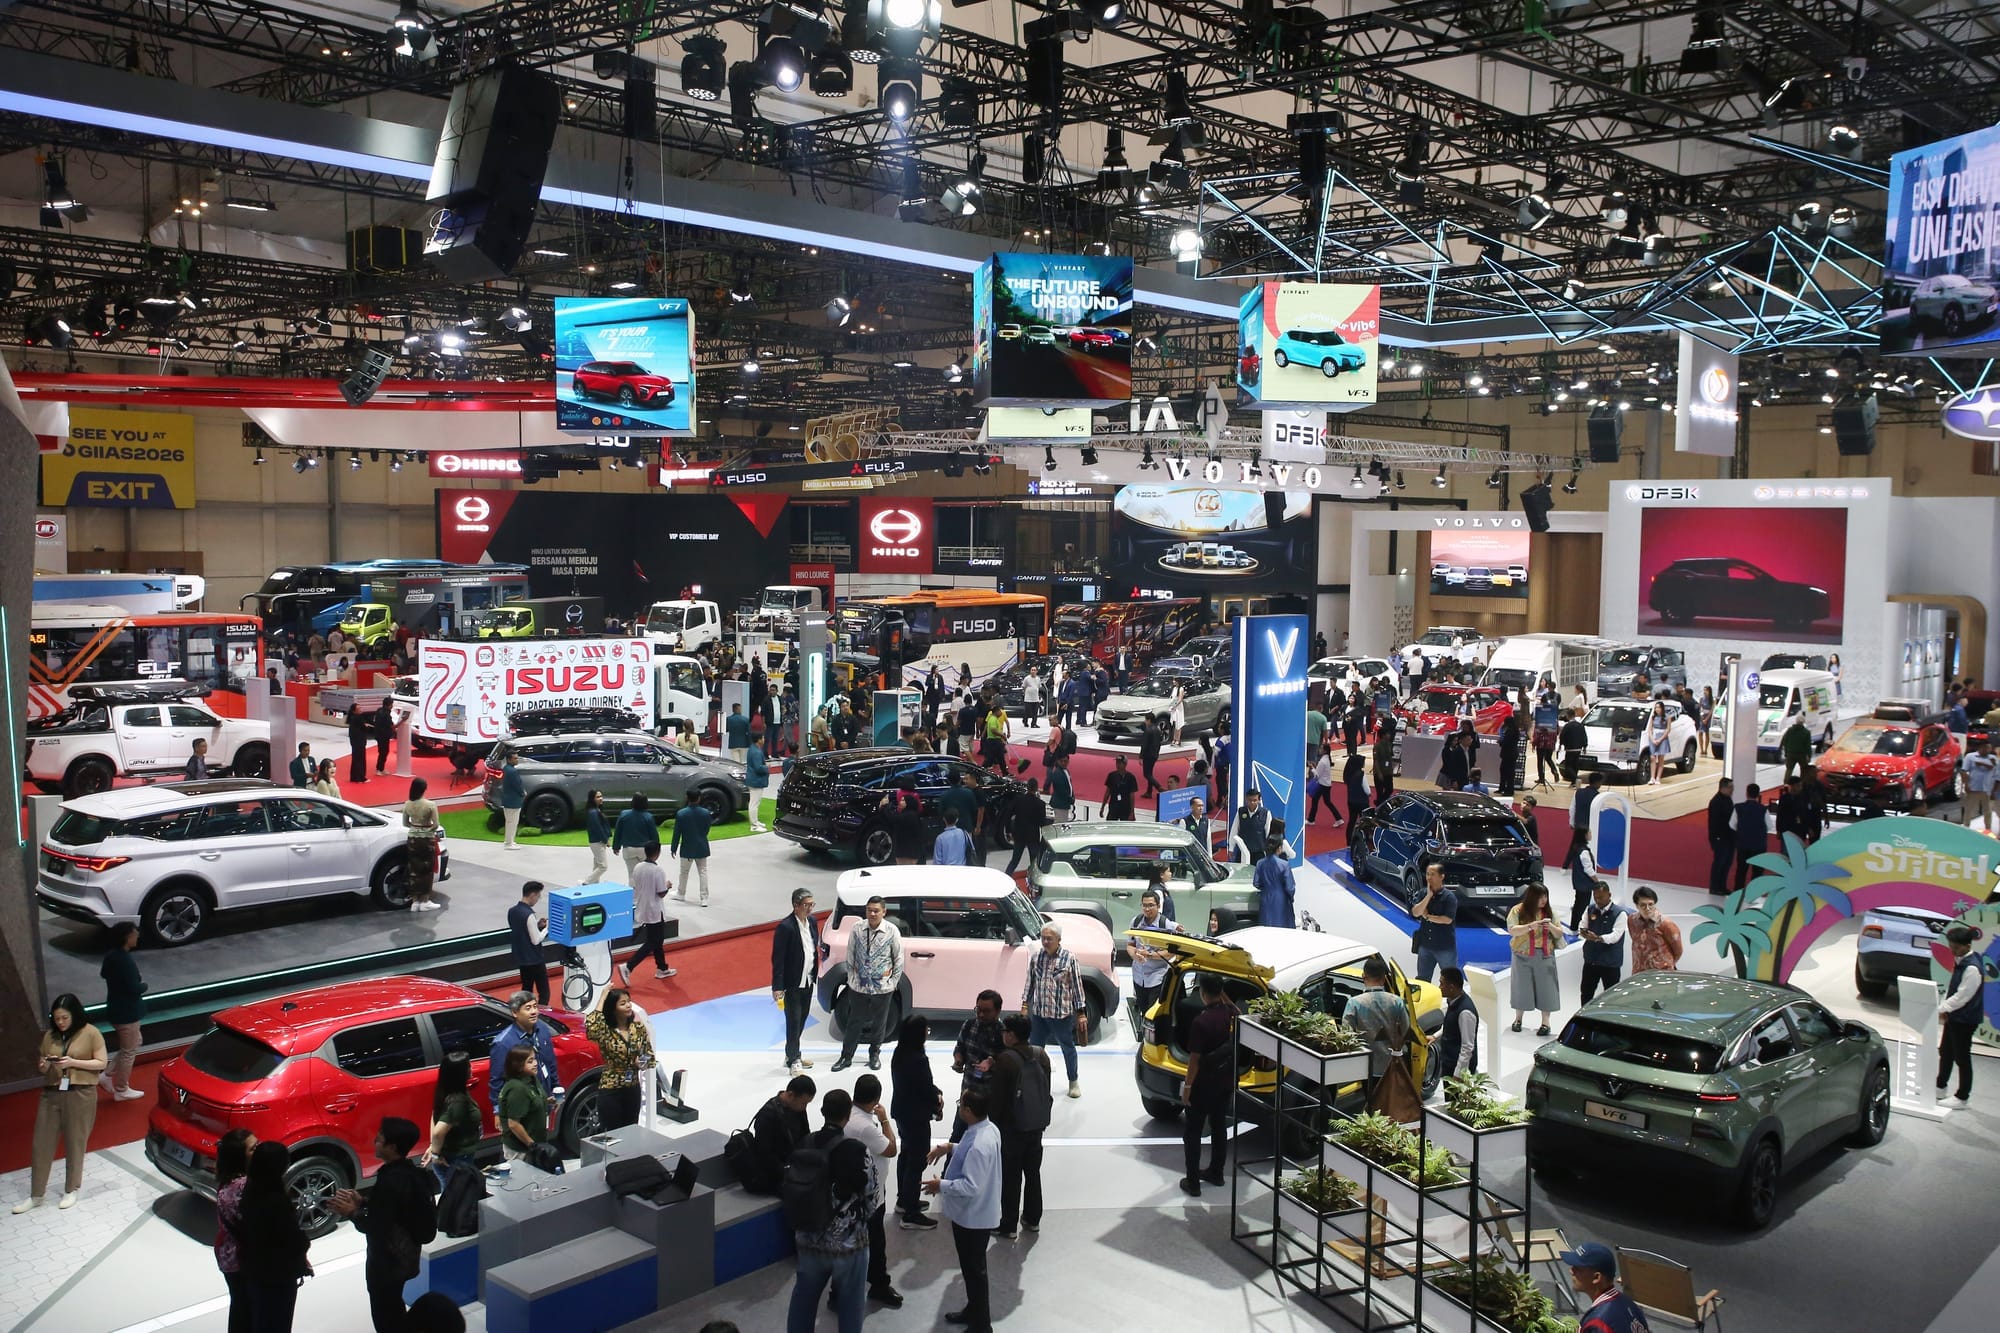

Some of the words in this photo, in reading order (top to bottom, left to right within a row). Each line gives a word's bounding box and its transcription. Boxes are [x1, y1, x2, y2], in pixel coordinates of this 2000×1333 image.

[1912, 175, 1946, 211] EASY
[1008, 279, 1031, 289] THE
[1031, 279, 1100, 295] FUTURE
[1031, 294, 1119, 310] UNBOUND
[1350, 320, 1377, 332] Vibe
[72, 428, 106, 440] SEE
[112, 430, 148, 442] YOU
[1276, 423, 1327, 447] DFSK
[462, 459, 522, 472] HINO
[727, 473, 767, 484] FUSO
[1166, 458, 1322, 489] VOLVO
[87, 481, 155, 499] EXIT
[1641, 487, 1698, 499] DFSK
[1776, 487, 1869, 498] SERES
[1434, 518, 1522, 528] VOLVO
[872, 547, 919, 557] HINO
[531, 556, 567, 565] BERSAMA
[568, 556, 598, 565] MENUJU
[551, 567, 573, 575] MASA
[574, 567, 598, 575] DEPAN
[795, 571, 809, 579] HINO
[809, 570, 830, 579] LOUNGE
[953, 619, 996, 634] FUSO
[138, 662, 181, 674] ELF
[505, 663, 625, 695] ISUZU
[1258, 680, 1305, 696] VINFAST
